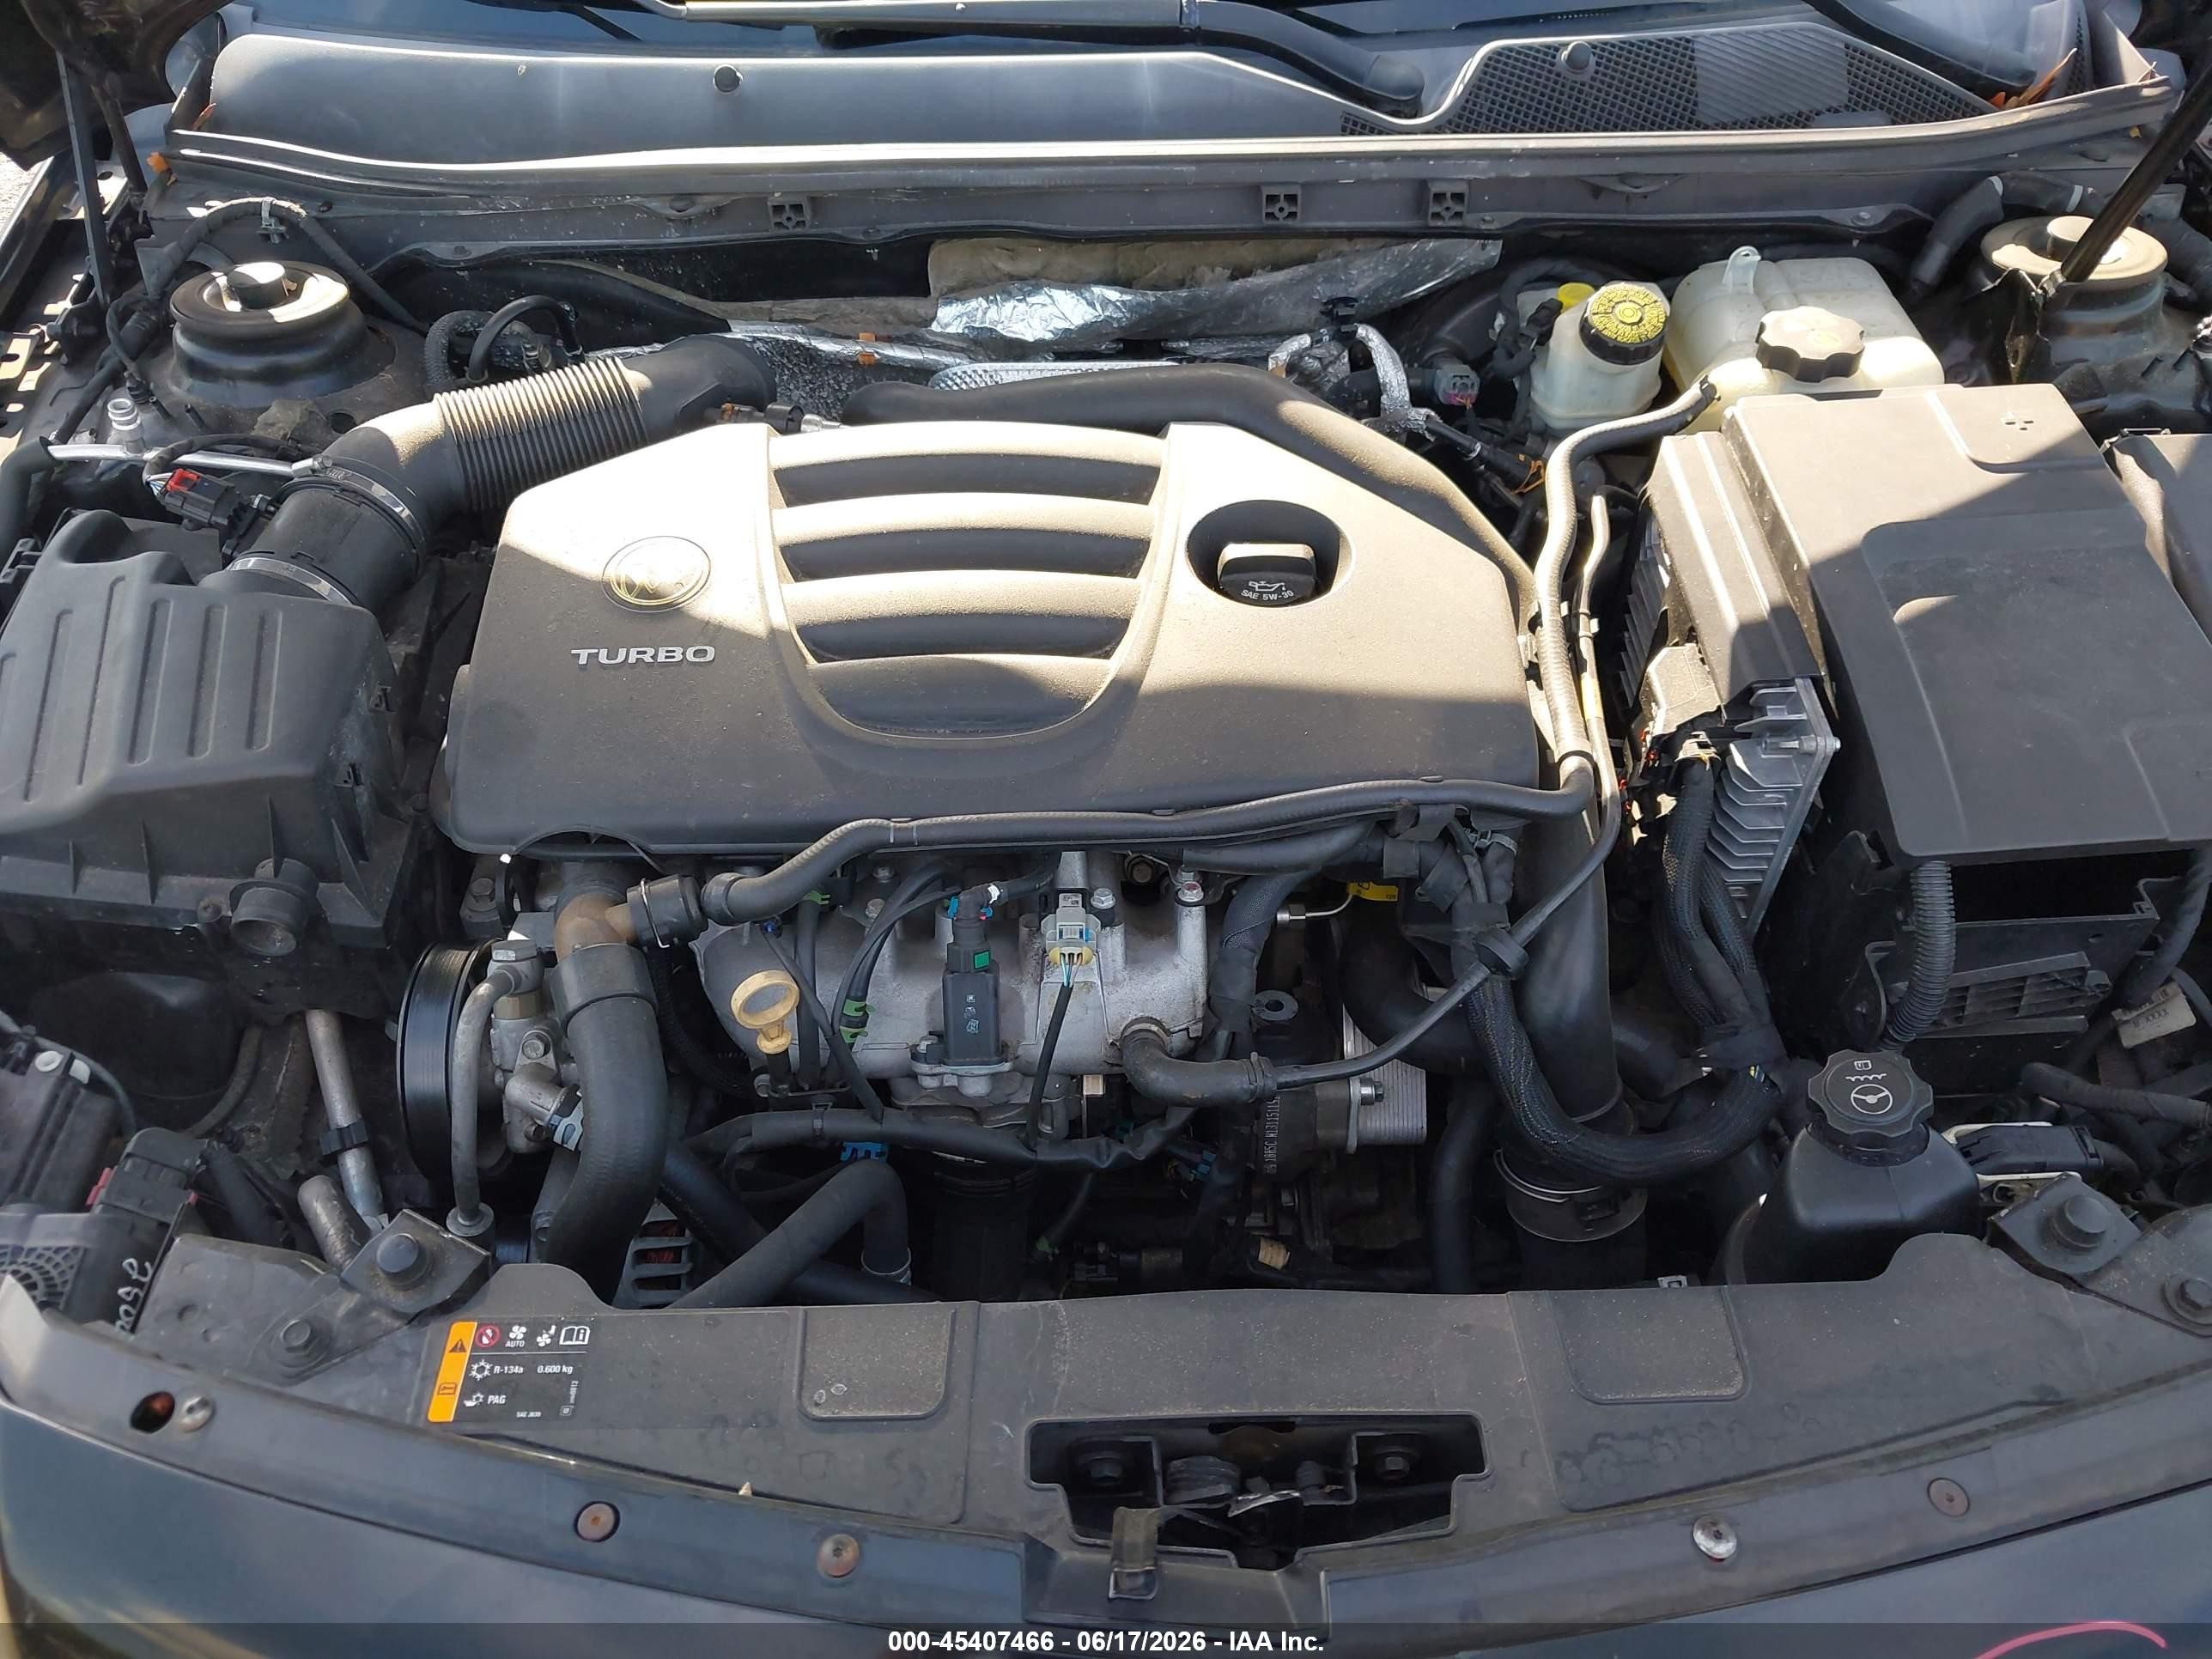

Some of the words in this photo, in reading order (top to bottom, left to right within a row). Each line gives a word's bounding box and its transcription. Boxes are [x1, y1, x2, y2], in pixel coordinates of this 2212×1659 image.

[1241, 589, 1260, 599] SAE
[1262, 590, 1294, 601] 5W-30
[571, 645, 715, 665] TURBO
[493, 1365, 524, 1374] R-134a
[537, 1365, 561, 1374] 0.600
[562, 1365, 574, 1375] kg
[487, 1395, 507, 1405] PAG
